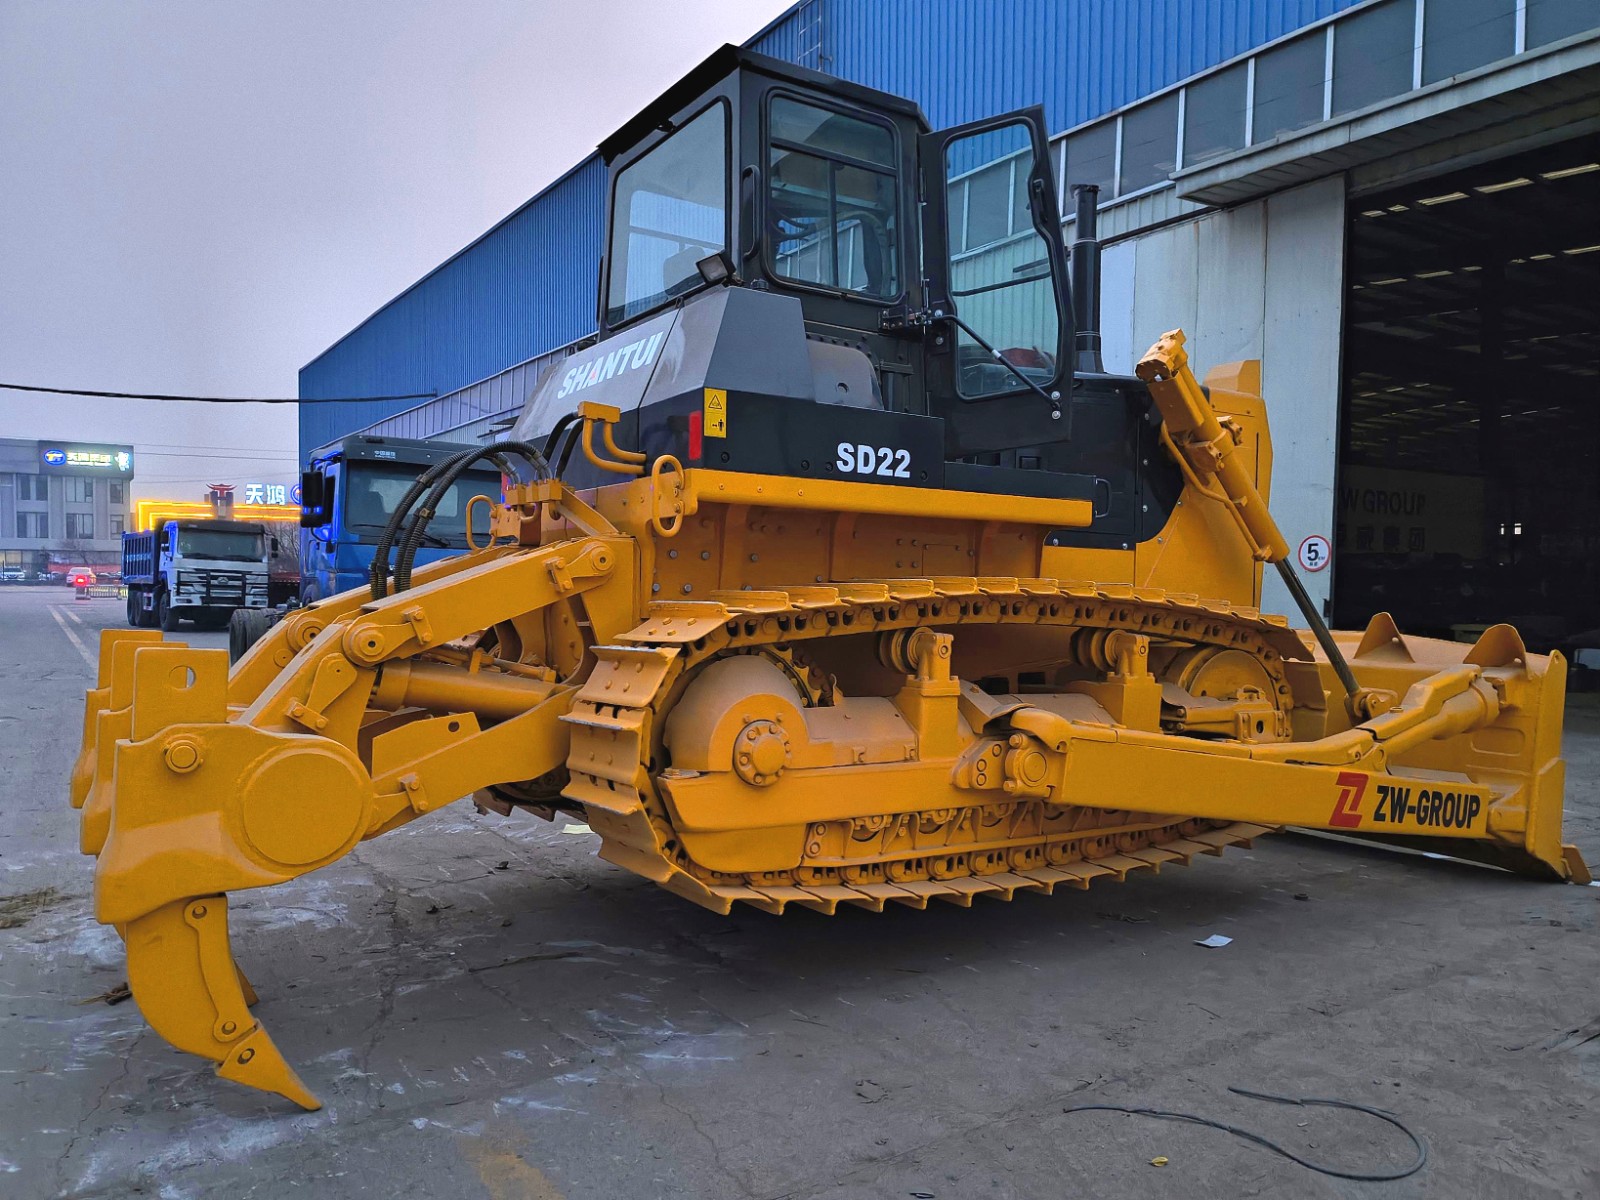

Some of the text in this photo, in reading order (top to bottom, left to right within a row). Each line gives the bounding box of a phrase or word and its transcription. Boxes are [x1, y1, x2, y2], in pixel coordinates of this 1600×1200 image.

[557, 331, 663, 399] SHANTUI
[836, 442, 911, 478] SD22
[1307, 543, 1319, 561] 5
[1373, 785, 1481, 829] ZW-GROUP
